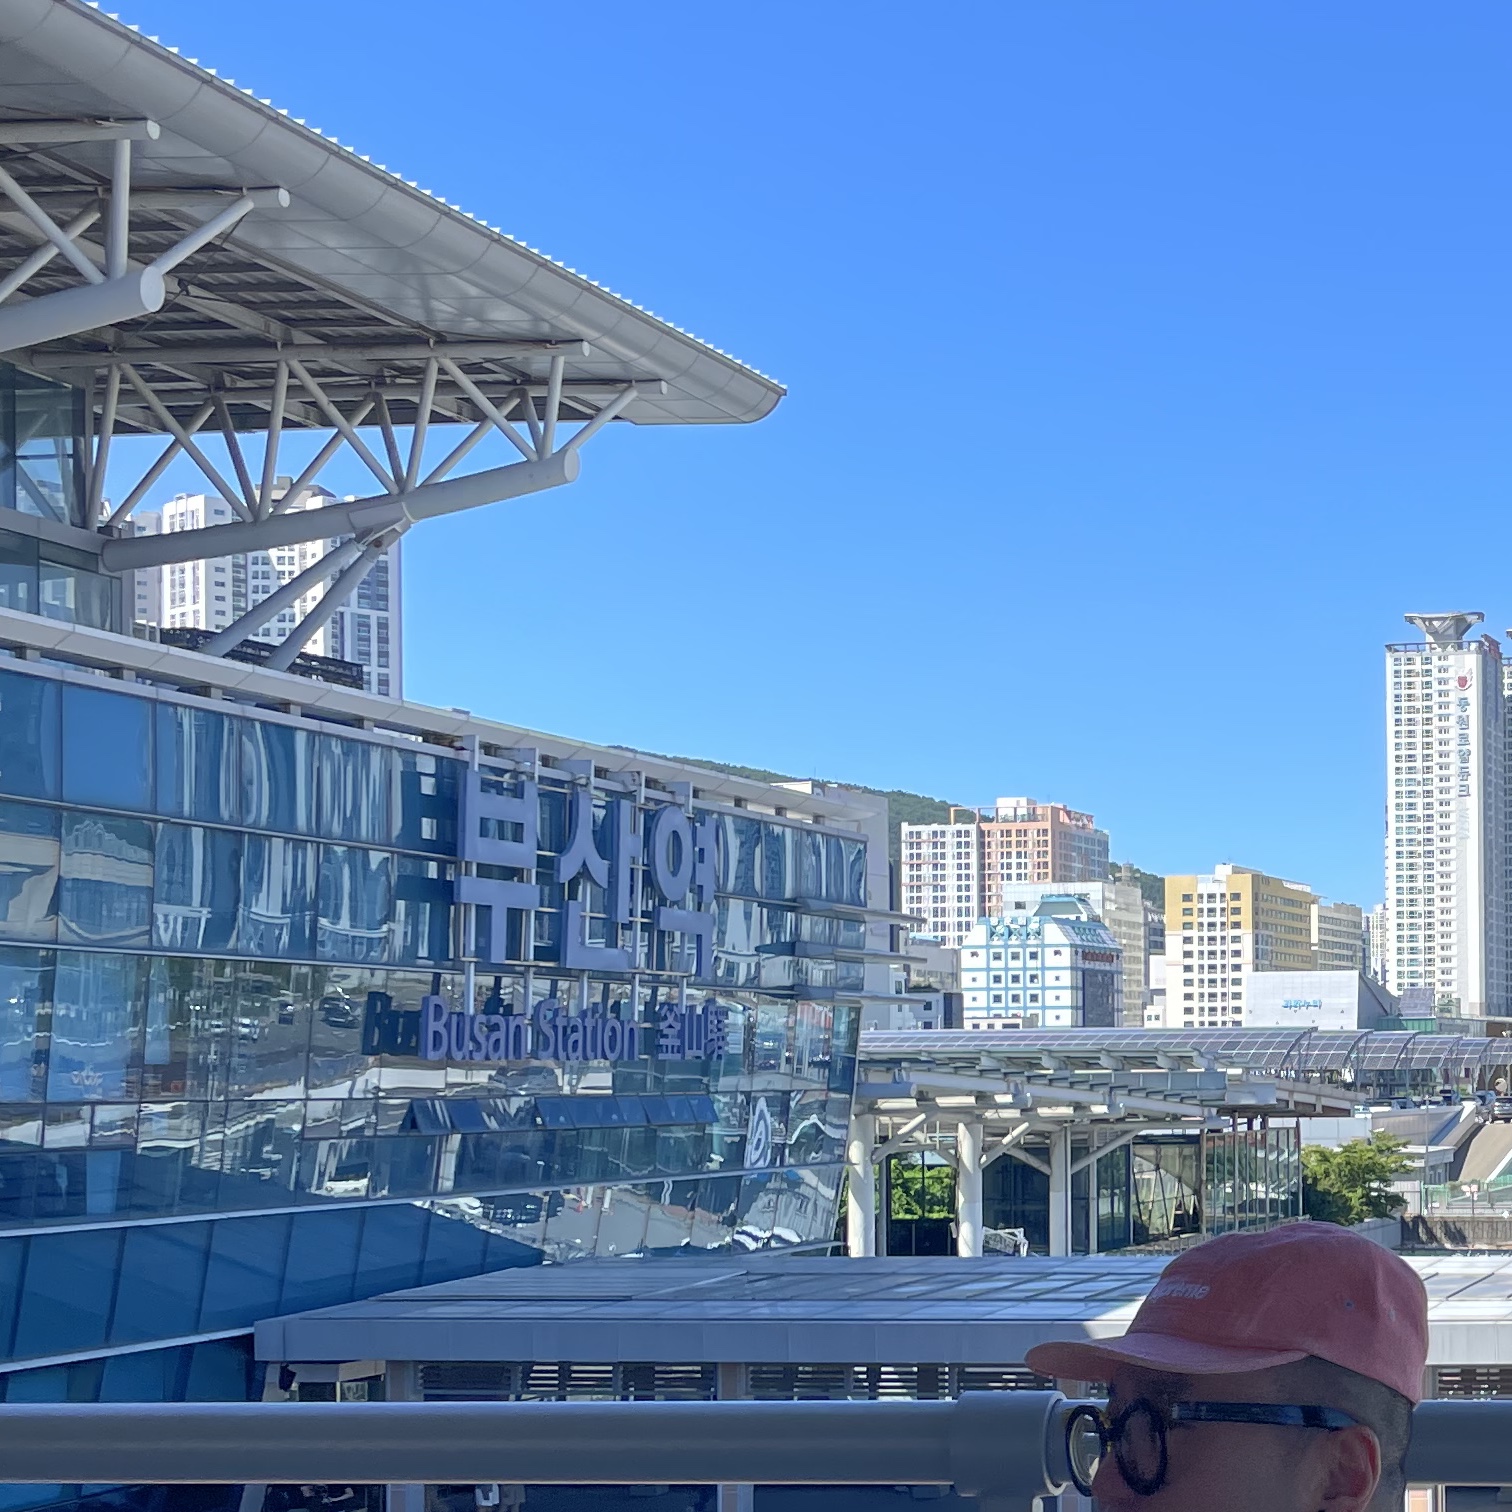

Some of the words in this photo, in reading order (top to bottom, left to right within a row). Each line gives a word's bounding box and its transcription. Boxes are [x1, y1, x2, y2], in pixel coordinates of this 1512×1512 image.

[454, 767, 717, 978] 부산역
[421, 995, 527, 1061] Busan
[535, 998, 640, 1061] Station
